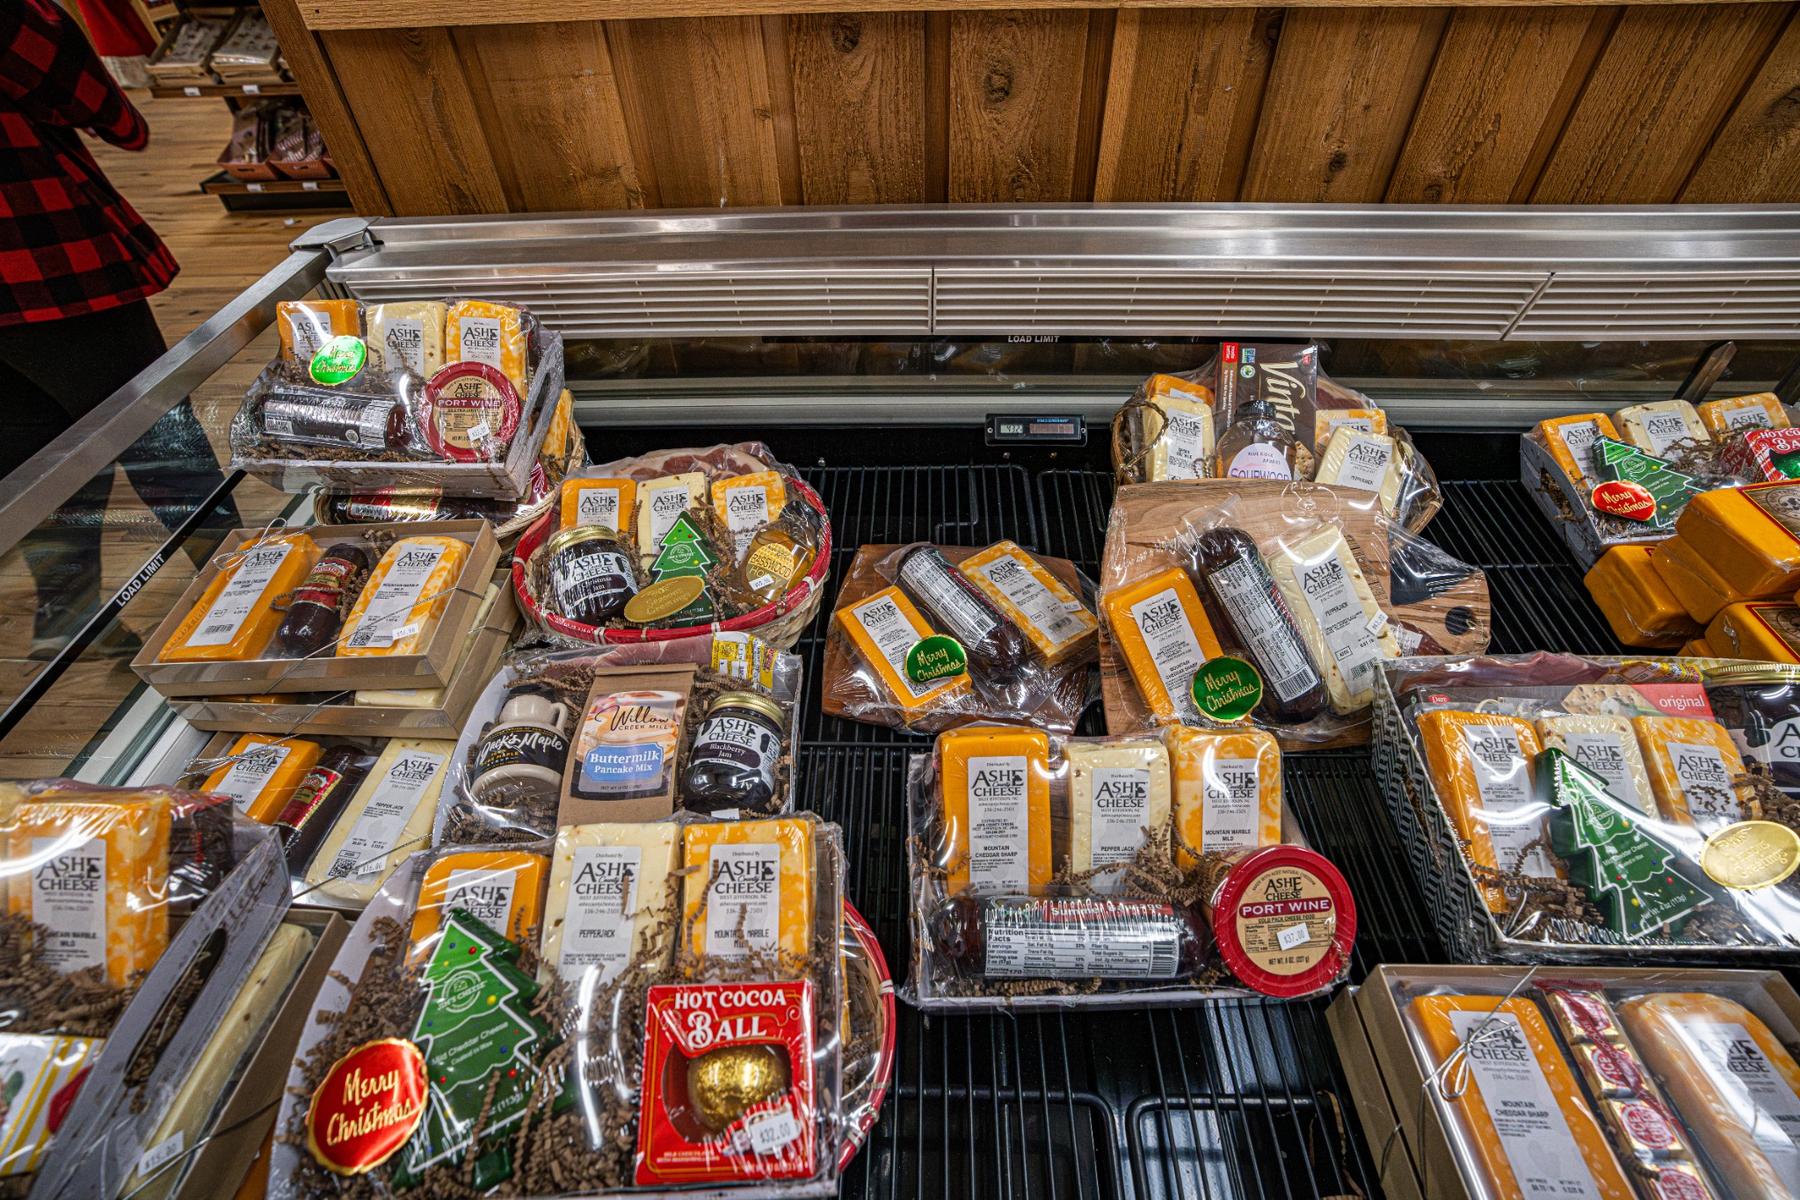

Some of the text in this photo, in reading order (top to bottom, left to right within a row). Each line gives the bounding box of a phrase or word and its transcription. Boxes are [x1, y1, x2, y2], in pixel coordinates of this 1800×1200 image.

[386, 328, 421, 341] ASHE
[463, 327, 498, 340] ASHE
[1008, 335, 1060, 343] LOAD LIMIT
[464, 340, 496, 348] CHEESE
[454, 382, 482, 394] ASHE
[438, 399, 500, 407] PORT WINE
[1169, 417, 1200, 431] ASHE
[1647, 418, 1682, 430] ASHE
[1731, 412, 1768, 426] ASHE
[1760, 429, 1783, 439] HOT
[1348, 444, 1389, 461] ASHE
[1349, 453, 1383, 466] CHEESE
[580, 496, 617, 508] ASHE
[653, 493, 688, 507] ASHE
[729, 493, 765, 507] ASHE
[1601, 491, 1637, 505] Merry
[653, 503, 685, 512] CHEESE
[1606, 500, 1652, 514] Christmas
[398, 551, 440, 562] ASHE
[573, 553, 613, 569] ASHE
[750, 553, 792, 579] BASSWOOD
[116, 553, 165, 607] LOAD LIMIT
[1303, 559, 1342, 590] ASHE
[1307, 572, 1343, 594] CHEESE
[863, 602, 896, 623] ASHE
[1142, 599, 1180, 629] ASHE
[1145, 612, 1182, 634] CHEESE
[917, 648, 949, 667] Merry
[917, 659, 964, 681] Christmas
[1204, 671, 1241, 692] Merry
[1206, 684, 1259, 712] Christmas
[1659, 695, 1705, 712] original
[595, 705, 669, 731] Willow
[710, 718, 760, 737] ASHE
[709, 732, 753, 747] CHEESE
[476, 733, 563, 767] Jack's Maple
[709, 742, 747, 756] Blackberry
[718, 750, 733, 758] Jam
[1576, 745, 1623, 761] ASHE
[590, 750, 660, 764] Buttermilk
[236, 764, 271, 775] CHEESE
[391, 759, 439, 775] ASHE
[594, 763, 653, 774] Pancake Mix
[1678, 755, 1724, 774] ASHE
[391, 769, 428, 781] CHEESE
[972, 770, 1024, 789] ASHE
[1681, 770, 1726, 783] CHEESE
[974, 787, 1022, 797] CHEESE
[1095, 781, 1148, 800] ASHE
[1097, 799, 1145, 808] CHEESE
[36, 857, 102, 880] ASHE
[574, 862, 638, 885] ASHE
[718, 861, 777, 882] ASHE
[38, 879, 98, 891] CHEESE
[576, 883, 624, 894] CHEES
[715, 882, 773, 894] CHEESE
[1264, 877, 1303, 895] ASHE
[452, 885, 511, 907] ASHE
[1266, 890, 1301, 901] CHEESE
[1242, 899, 1330, 916] PORT WINE
[73, 931, 96, 939] MARBLE
[747, 929, 770, 938] MARBLE
[675, 989, 787, 1009] HOT COCOA
[687, 1011, 768, 1049] BALL
[448, 1021, 508, 1057] Cheddar Cheese
[450, 1040, 494, 1066] Coated Wax
[1471, 1049, 1531, 1062] CHEESE
[342, 1067, 399, 1106] Merry
[1501, 1101, 1536, 1109] MOUNTAIN
[1495, 1109, 1527, 1118] CHEDDAR
[327, 1098, 420, 1146] Christmas
[759, 1122, 791, 1144] $32.00
